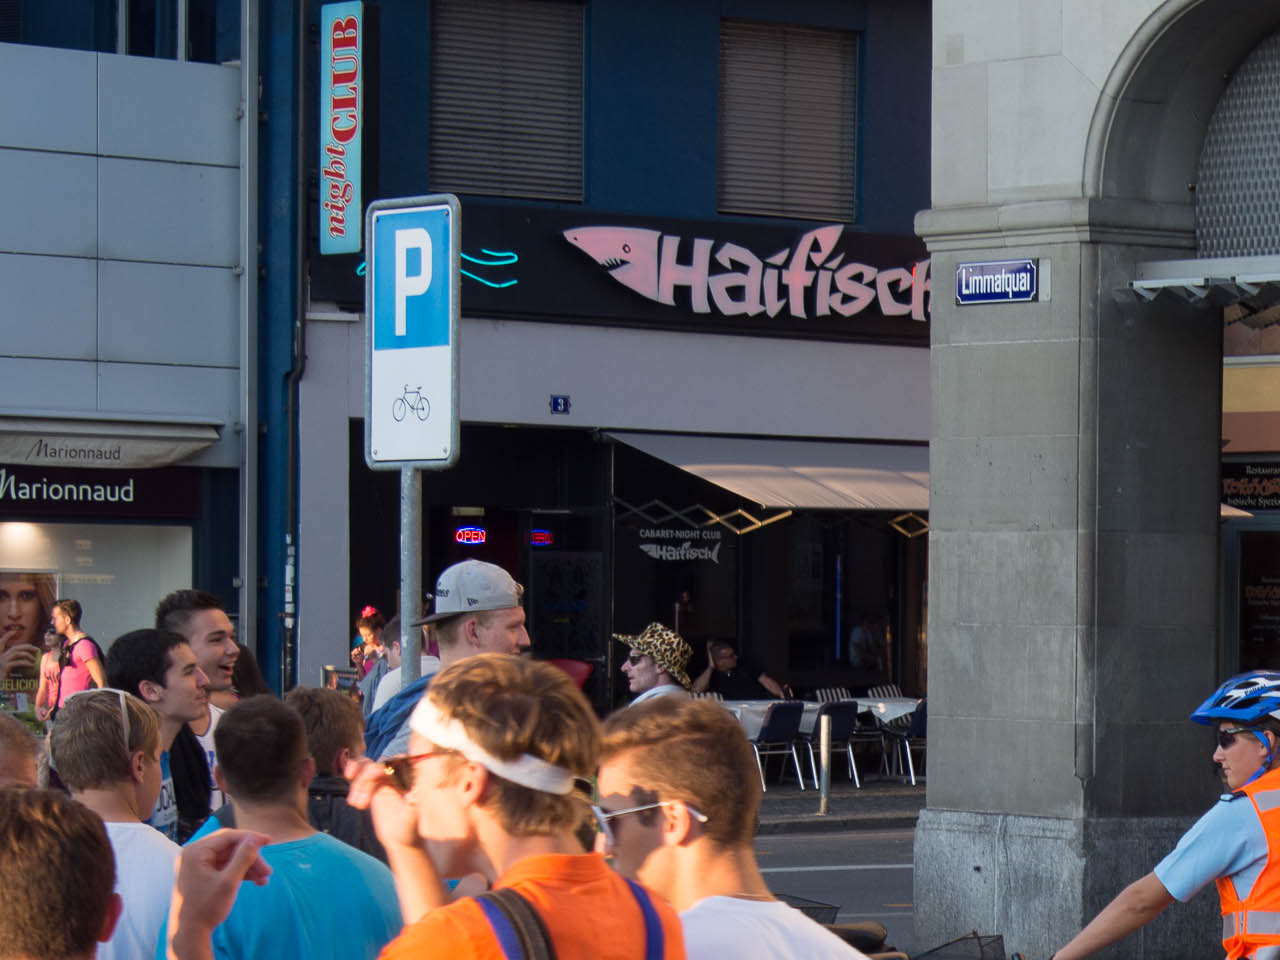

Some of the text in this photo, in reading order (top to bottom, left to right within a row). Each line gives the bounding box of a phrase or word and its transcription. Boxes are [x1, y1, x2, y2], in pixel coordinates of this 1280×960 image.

[322, 15, 360, 238] night CLUB
[394, 227, 432, 336] P
[961, 263, 1031, 299] Limmatquai
[557, 398, 564, 411] 3
[25, 438, 122, 461] Marionnaud
[0, 467, 135, 502] Marionnaud
[455, 529, 486, 544] OPEN
[639, 528, 721, 541] CABARET-NIGHT CLUB
